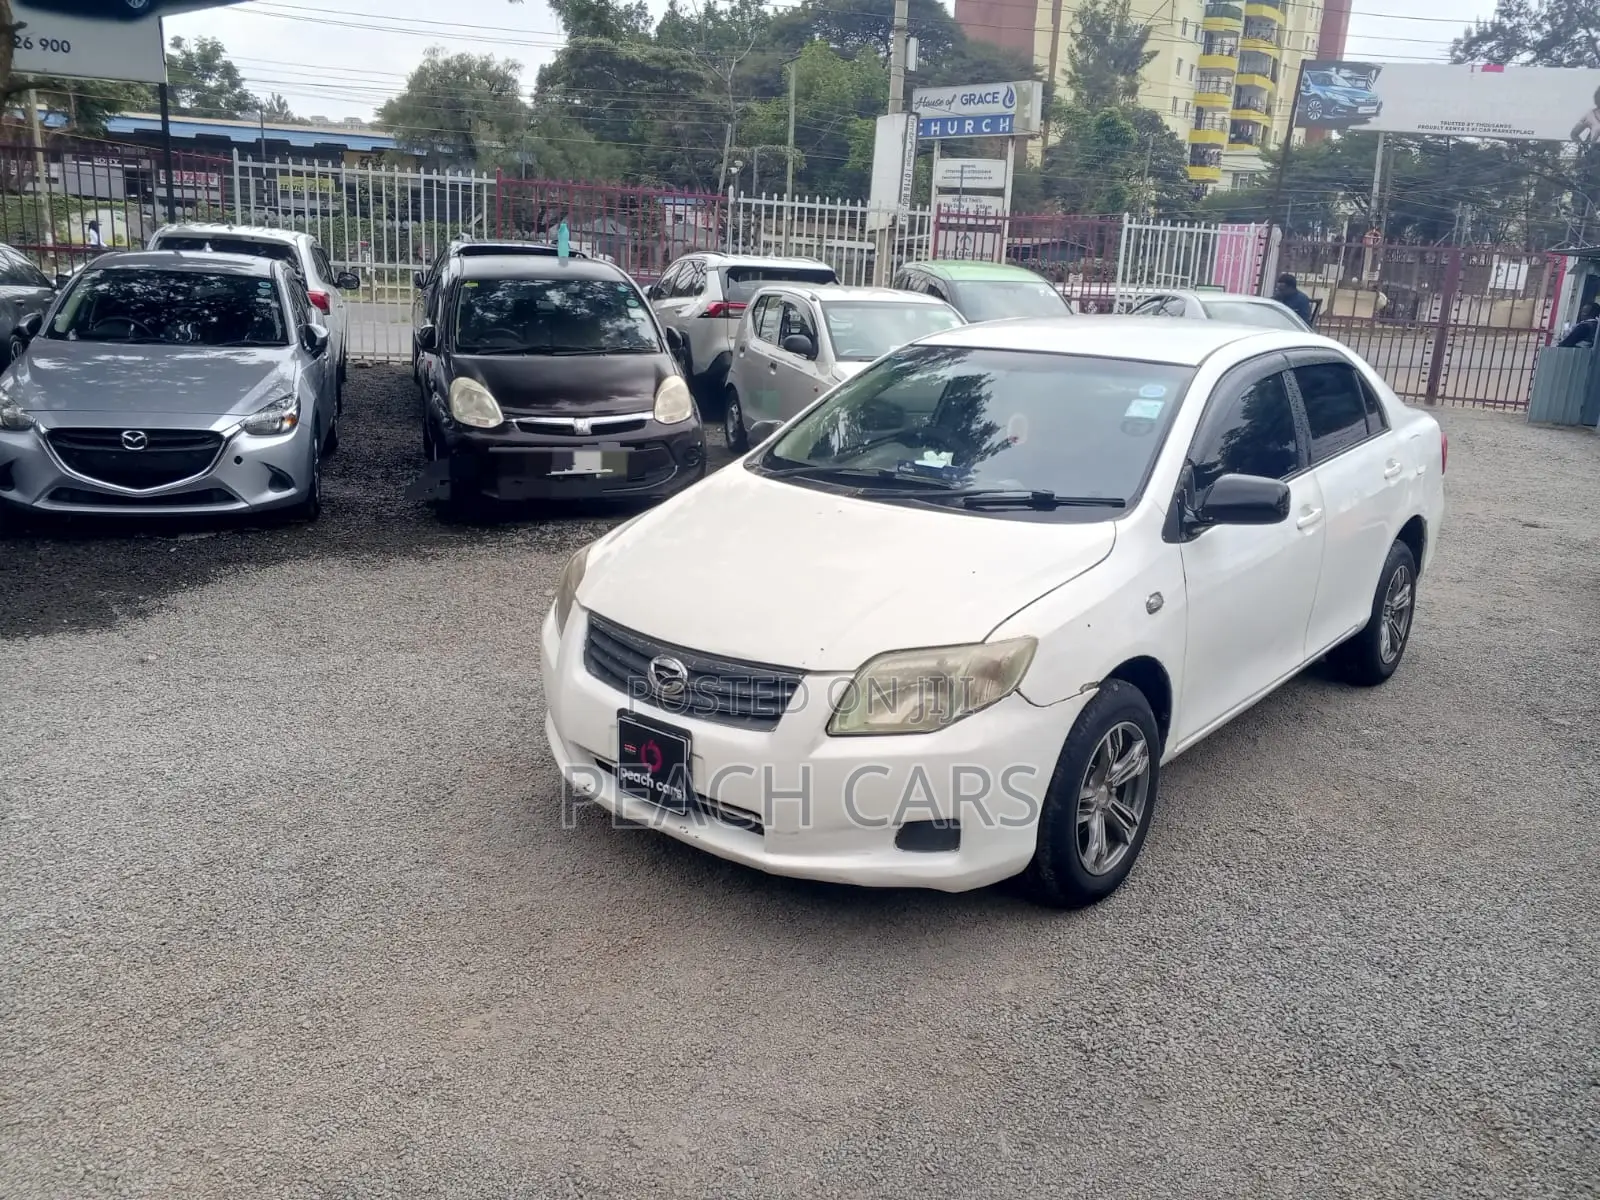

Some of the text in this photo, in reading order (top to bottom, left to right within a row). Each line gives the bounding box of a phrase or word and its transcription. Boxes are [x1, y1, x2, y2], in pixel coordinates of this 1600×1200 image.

[13, 35, 72, 54] 26 900
[914, 91, 1000, 110] House of GRACE
[620, 767, 683, 800] peach cars
